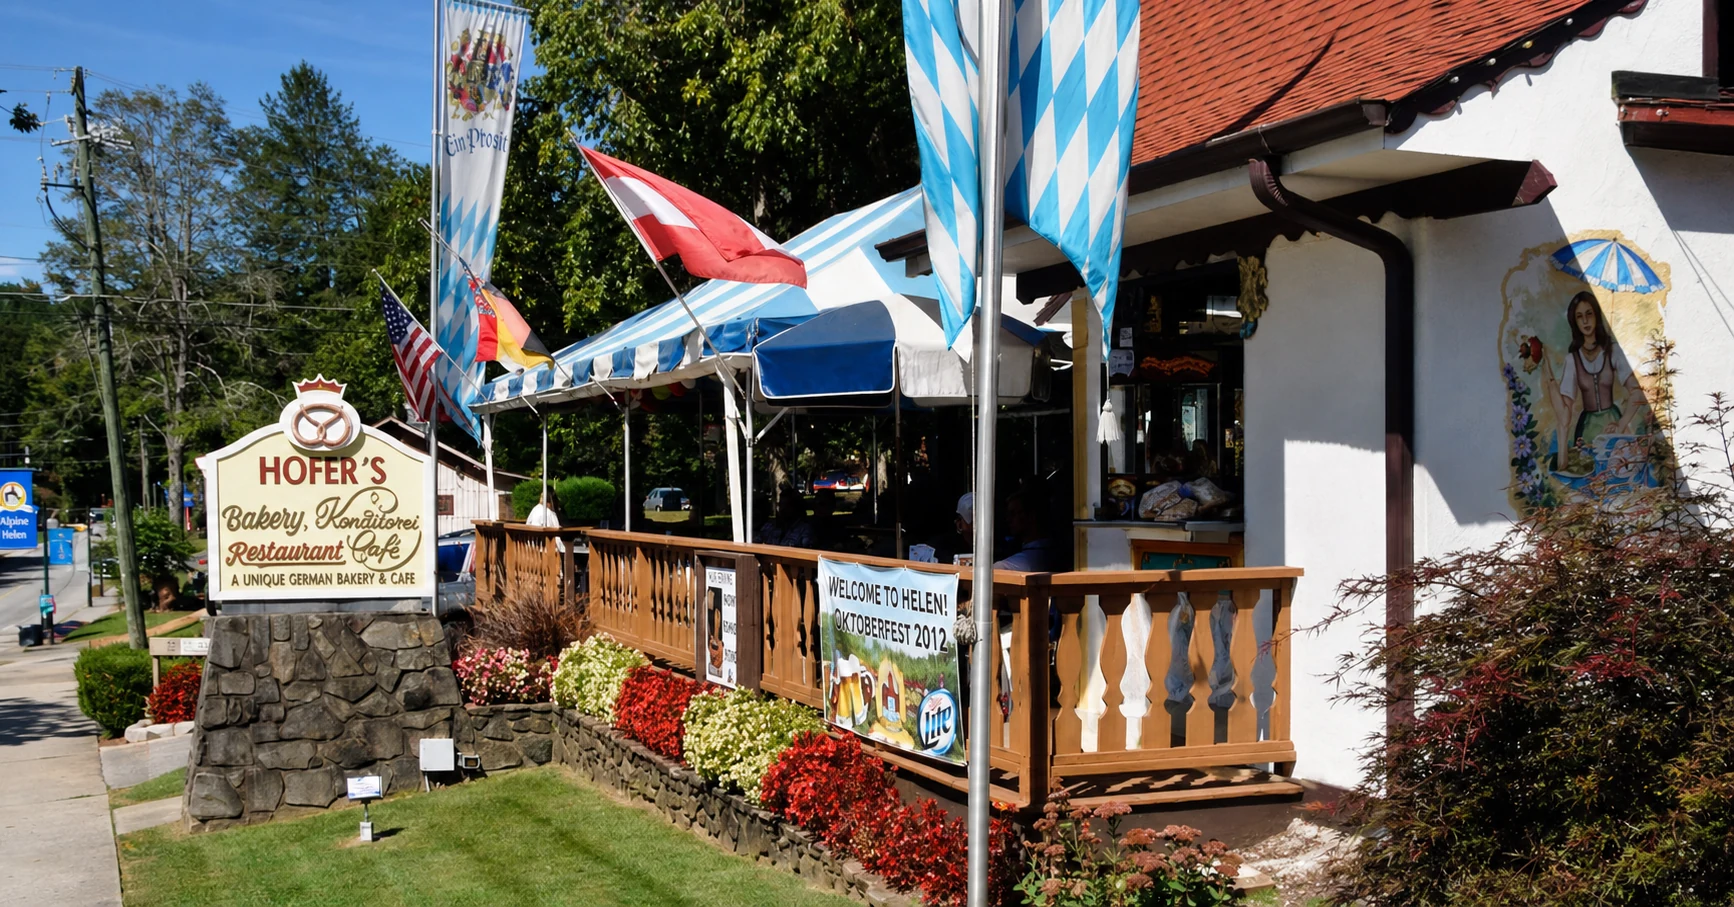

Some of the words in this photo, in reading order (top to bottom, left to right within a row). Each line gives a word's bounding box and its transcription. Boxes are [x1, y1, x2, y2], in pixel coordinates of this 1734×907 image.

[445, 133, 466, 157] Ein
[467, 128, 508, 154] Prosit
[259, 456, 387, 485] HOFER'S
[0, 516, 29, 528] Alpine
[222, 504, 309, 536] Bakery,
[315, 486, 420, 530] Konditorei
[2, 529, 27, 539] Helen
[226, 540, 346, 567] Restaurant
[346, 530, 421, 572] Café
[231, 574, 239, 586] A
[243, 573, 285, 587] UNIQUE
[289, 573, 333, 586] GERMAN
[337, 572, 375, 585] BAKERY
[378, 572, 387, 585] &
[390, 572, 416, 585] CAFE
[828, 576, 881, 605] WELCOME
[883, 586, 899, 608] TO
[902, 588, 948, 616] HELEN!
[835, 608, 911, 646] OKTOBERFEST
[914, 623, 948, 652] 2012
[923, 706, 951, 750] Lite
